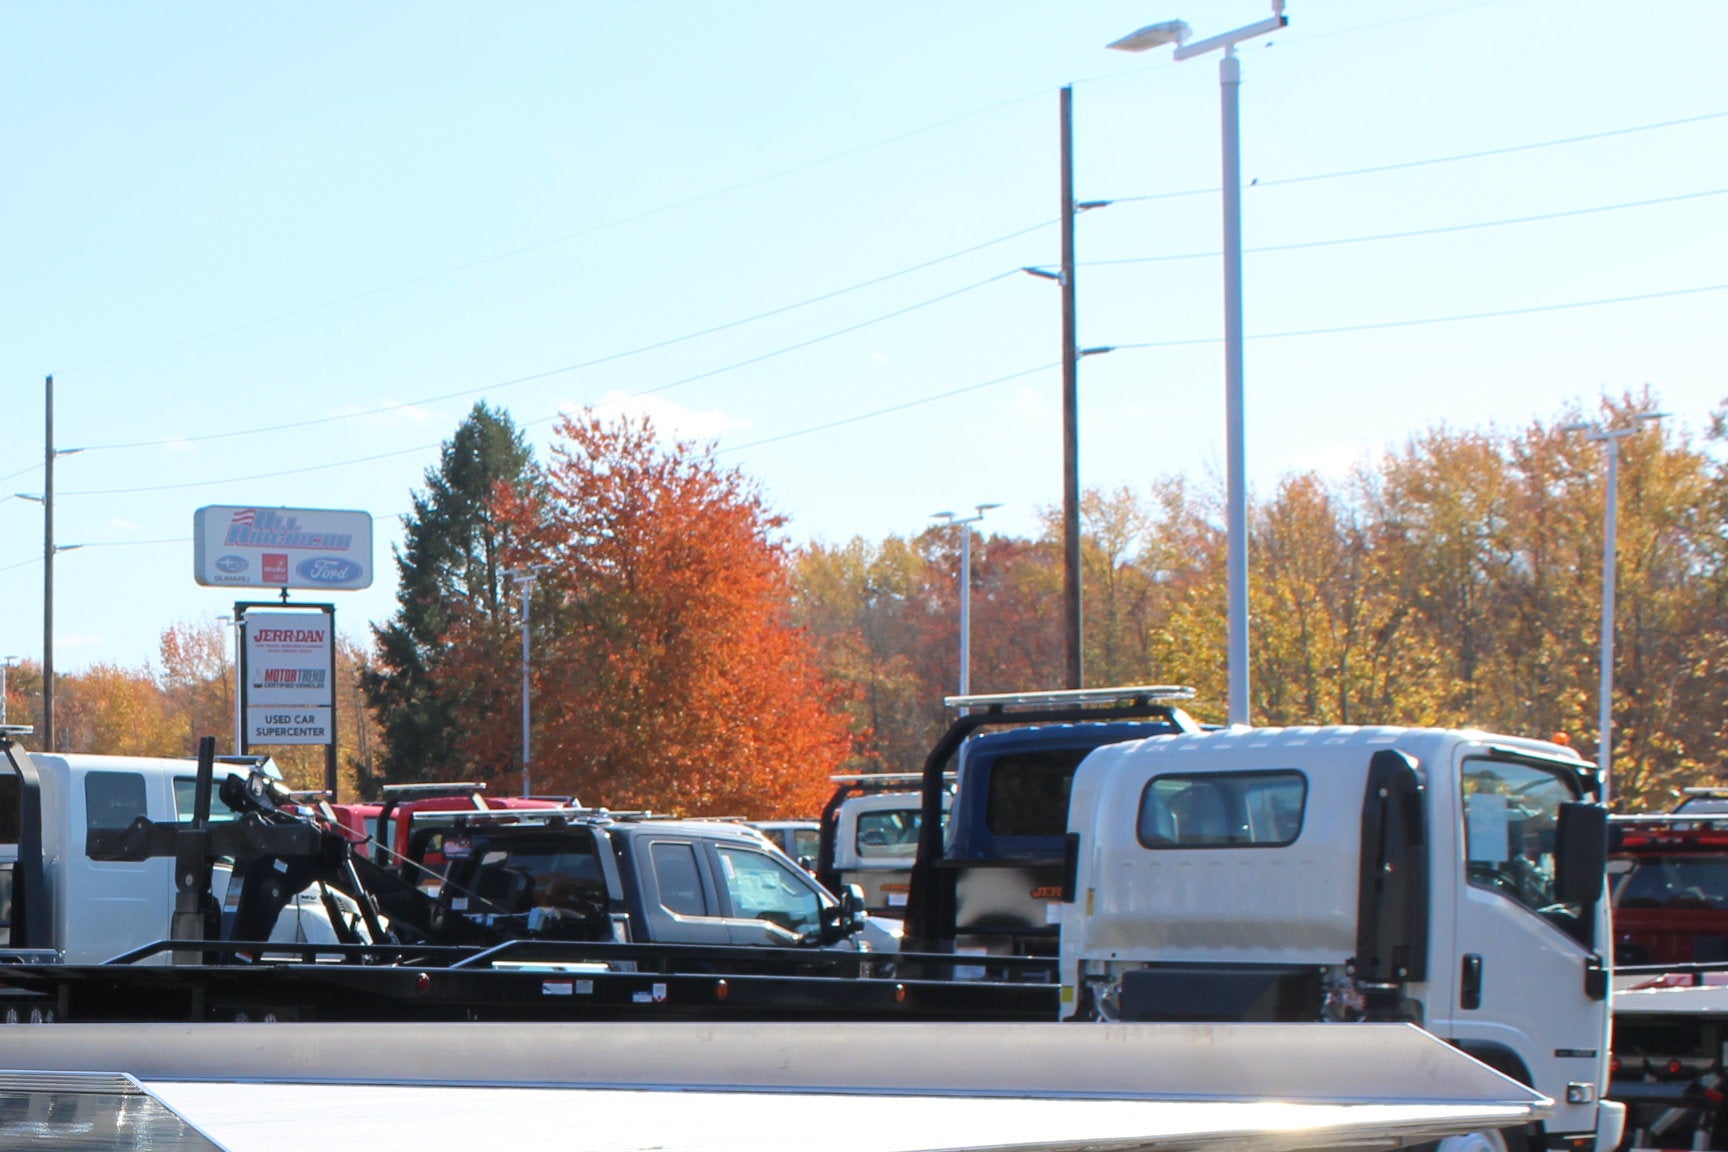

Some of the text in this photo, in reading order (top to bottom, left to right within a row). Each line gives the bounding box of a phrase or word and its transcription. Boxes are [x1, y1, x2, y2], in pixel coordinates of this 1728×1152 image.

[311, 558, 349, 580] Ford
[265, 715, 315, 724] USED CAR
[256, 727, 325, 736] SUPERCENTER
